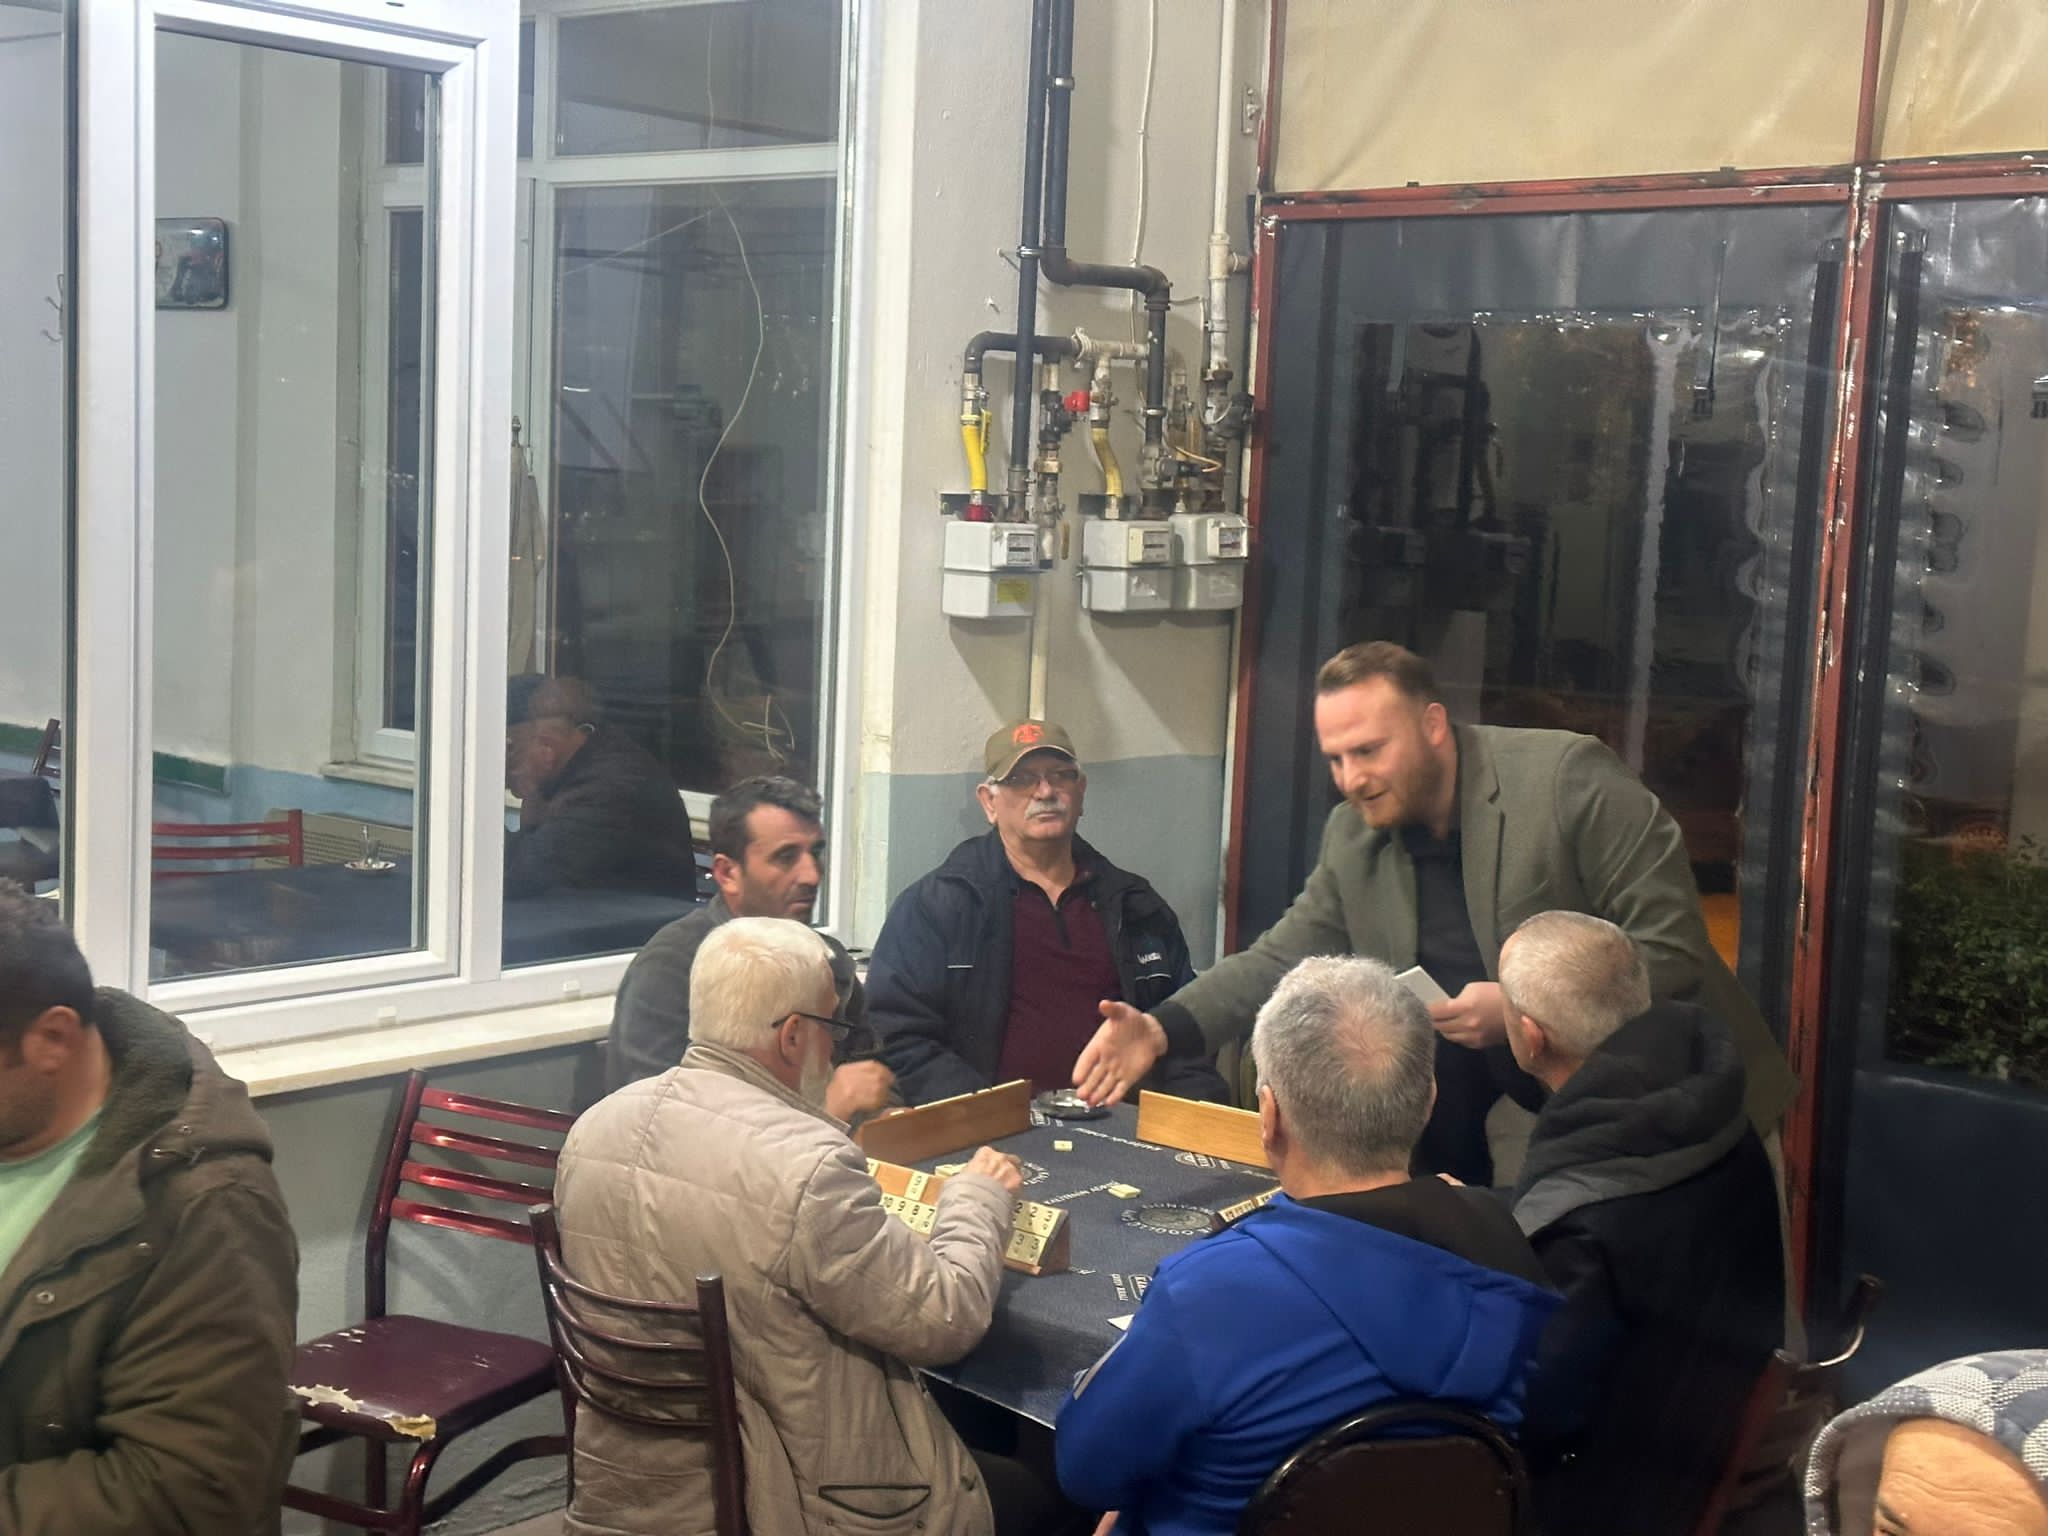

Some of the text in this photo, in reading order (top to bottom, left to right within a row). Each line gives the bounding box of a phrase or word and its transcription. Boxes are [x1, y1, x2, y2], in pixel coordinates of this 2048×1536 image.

[912, 1204, 920, 1216] 8
[927, 1208, 935, 1220] 7
[1014, 1202, 1053, 1222] 2 2 3
[1016, 1234, 1040, 1249] 3 3
